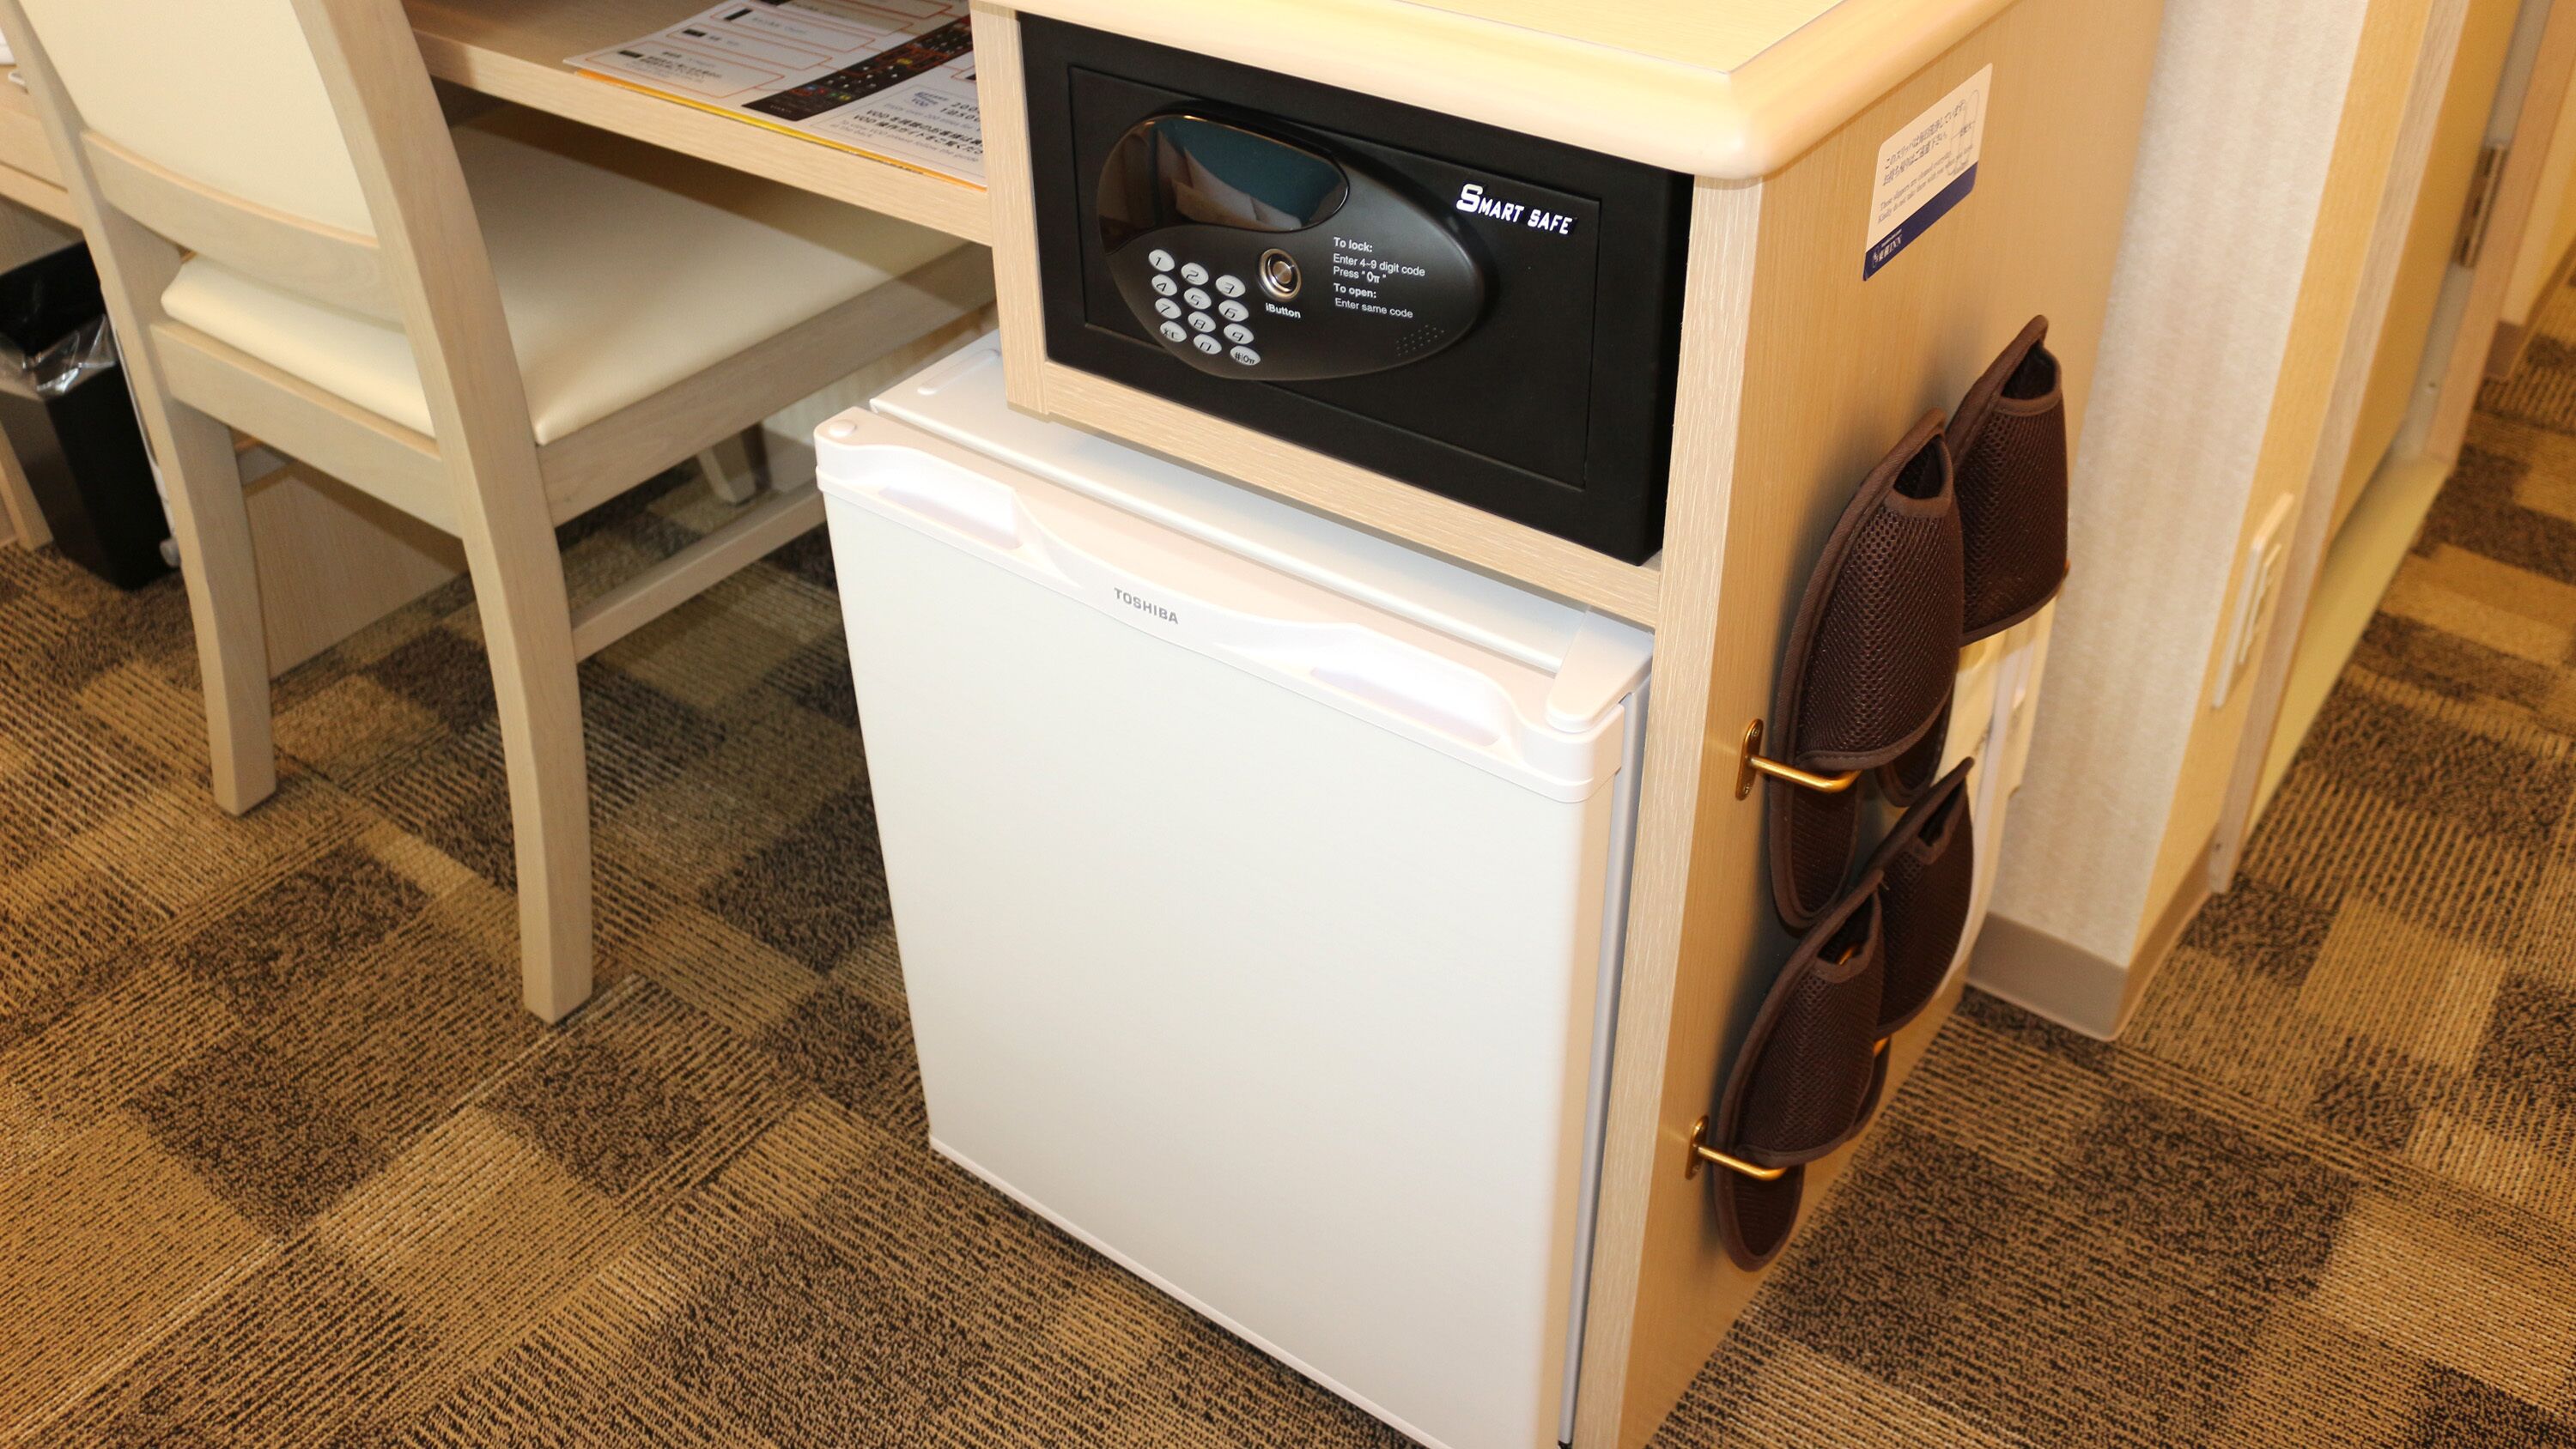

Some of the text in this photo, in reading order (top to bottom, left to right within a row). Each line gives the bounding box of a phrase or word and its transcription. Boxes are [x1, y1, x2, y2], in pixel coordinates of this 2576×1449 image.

[1456, 183, 1572, 234] SMART SAFE
[1333, 236, 1373, 252] To lock:
[1333, 253, 1358, 266] Enter
[1379, 261, 1400, 274] digit
[1401, 265, 1425, 277] code
[1333, 265, 1359, 279] Press
[1186, 269, 1200, 282] 2
[1333, 282, 1377, 299] To open:
[1190, 294, 1201, 306] 5
[1224, 307, 1238, 319] 6
[1265, 302, 1302, 318] iButton
[1334, 297, 1413, 318] Enter same code
[1193, 318, 1206, 330] 8
[1114, 587, 1179, 625] TOSHIBA
